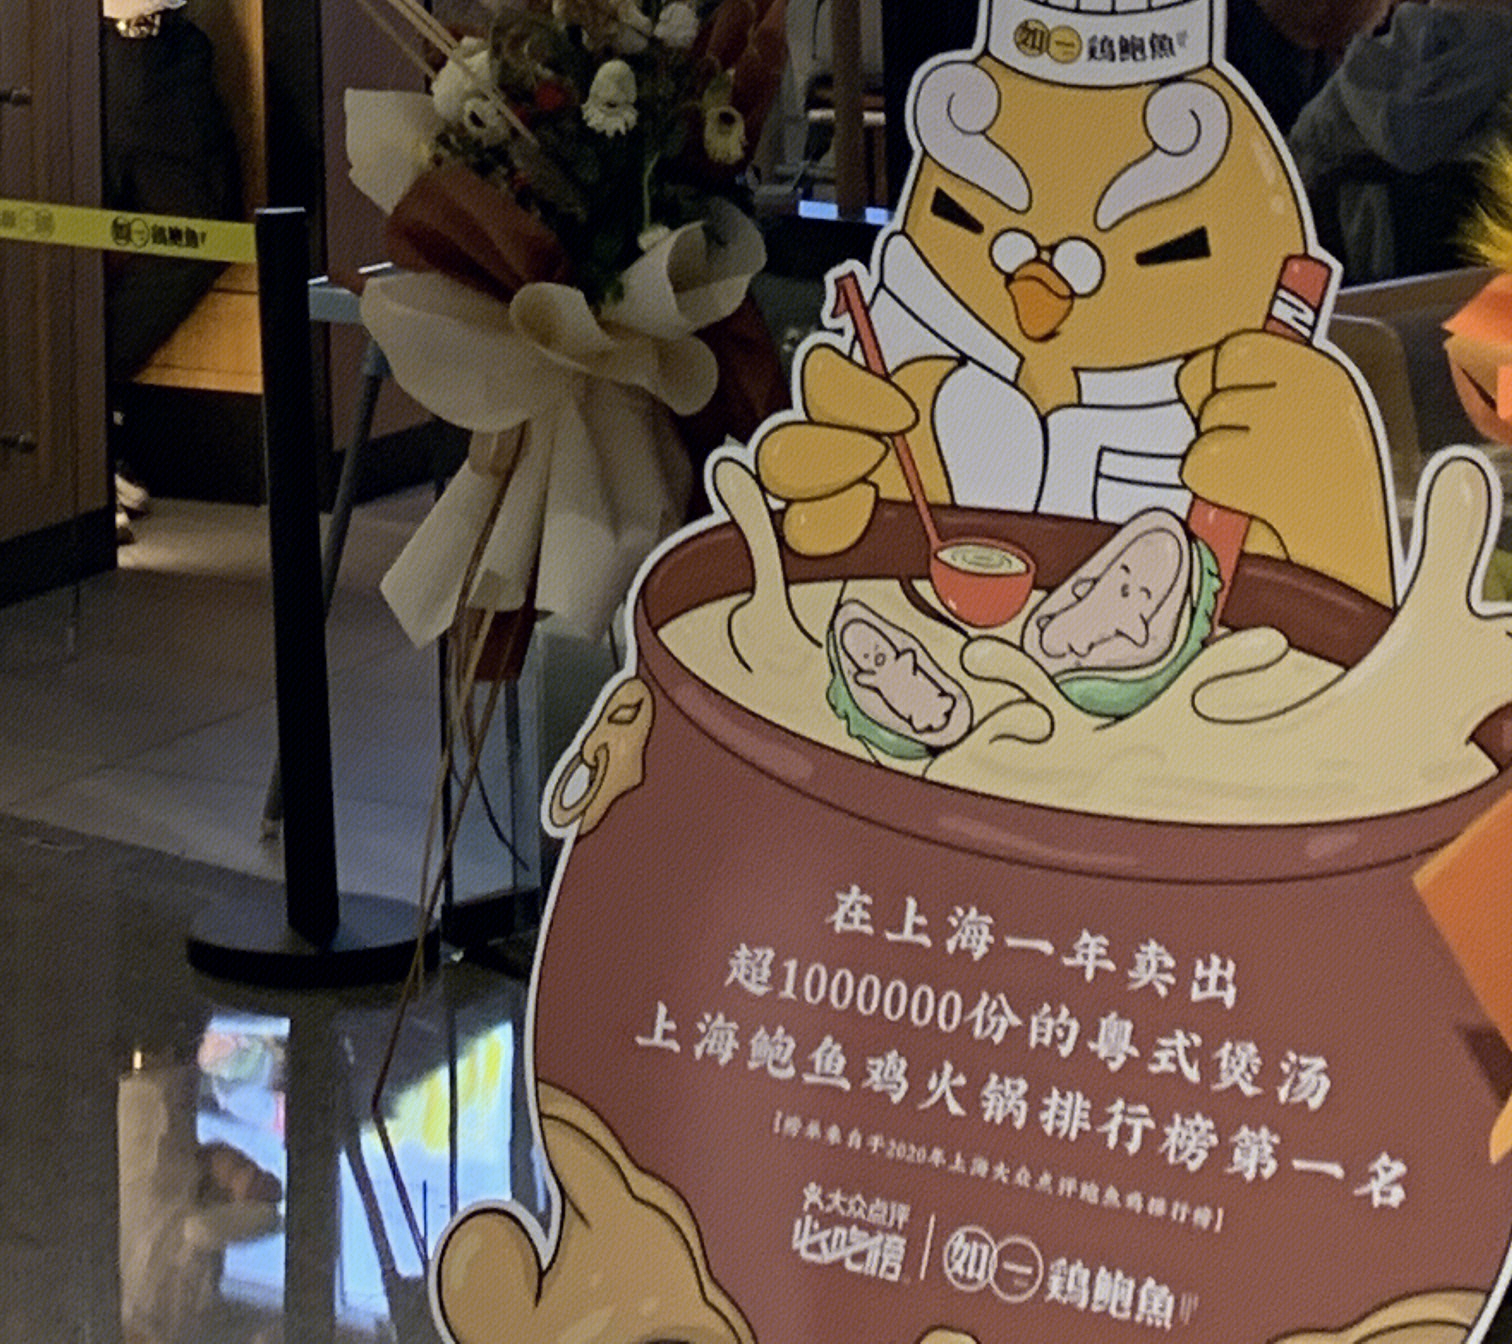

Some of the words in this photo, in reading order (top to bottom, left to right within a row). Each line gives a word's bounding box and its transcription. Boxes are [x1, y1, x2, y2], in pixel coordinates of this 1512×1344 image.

[724, 942, 1331, 1111] 超1000000份的粤式煲汤
[825, 884, 1237, 1010] 在上海一年卖出
[635, 1000, 1408, 1209] 上海鲍鱼鸡火锅排行榜第一名
